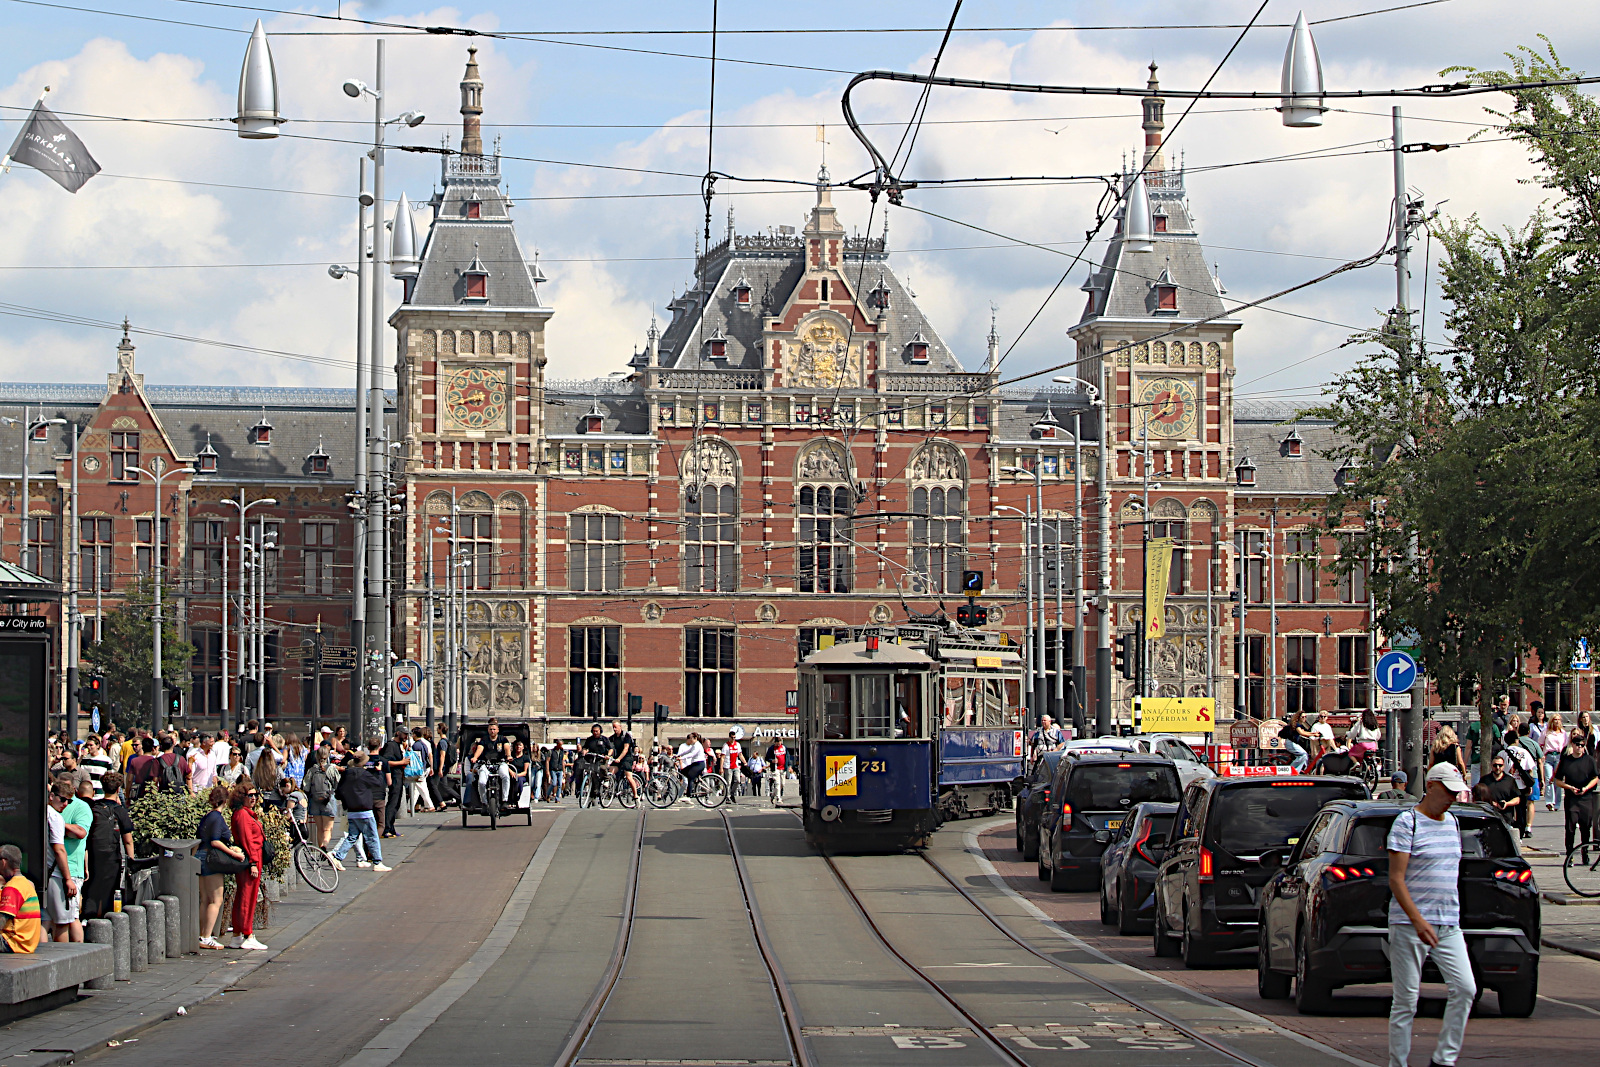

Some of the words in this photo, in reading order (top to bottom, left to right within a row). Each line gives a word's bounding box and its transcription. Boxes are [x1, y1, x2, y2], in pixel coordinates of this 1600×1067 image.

[12, 619, 28, 629] City
[29, 619, 45, 628] info
[787, 691, 798, 706] M
[861, 760, 887, 773] 731
